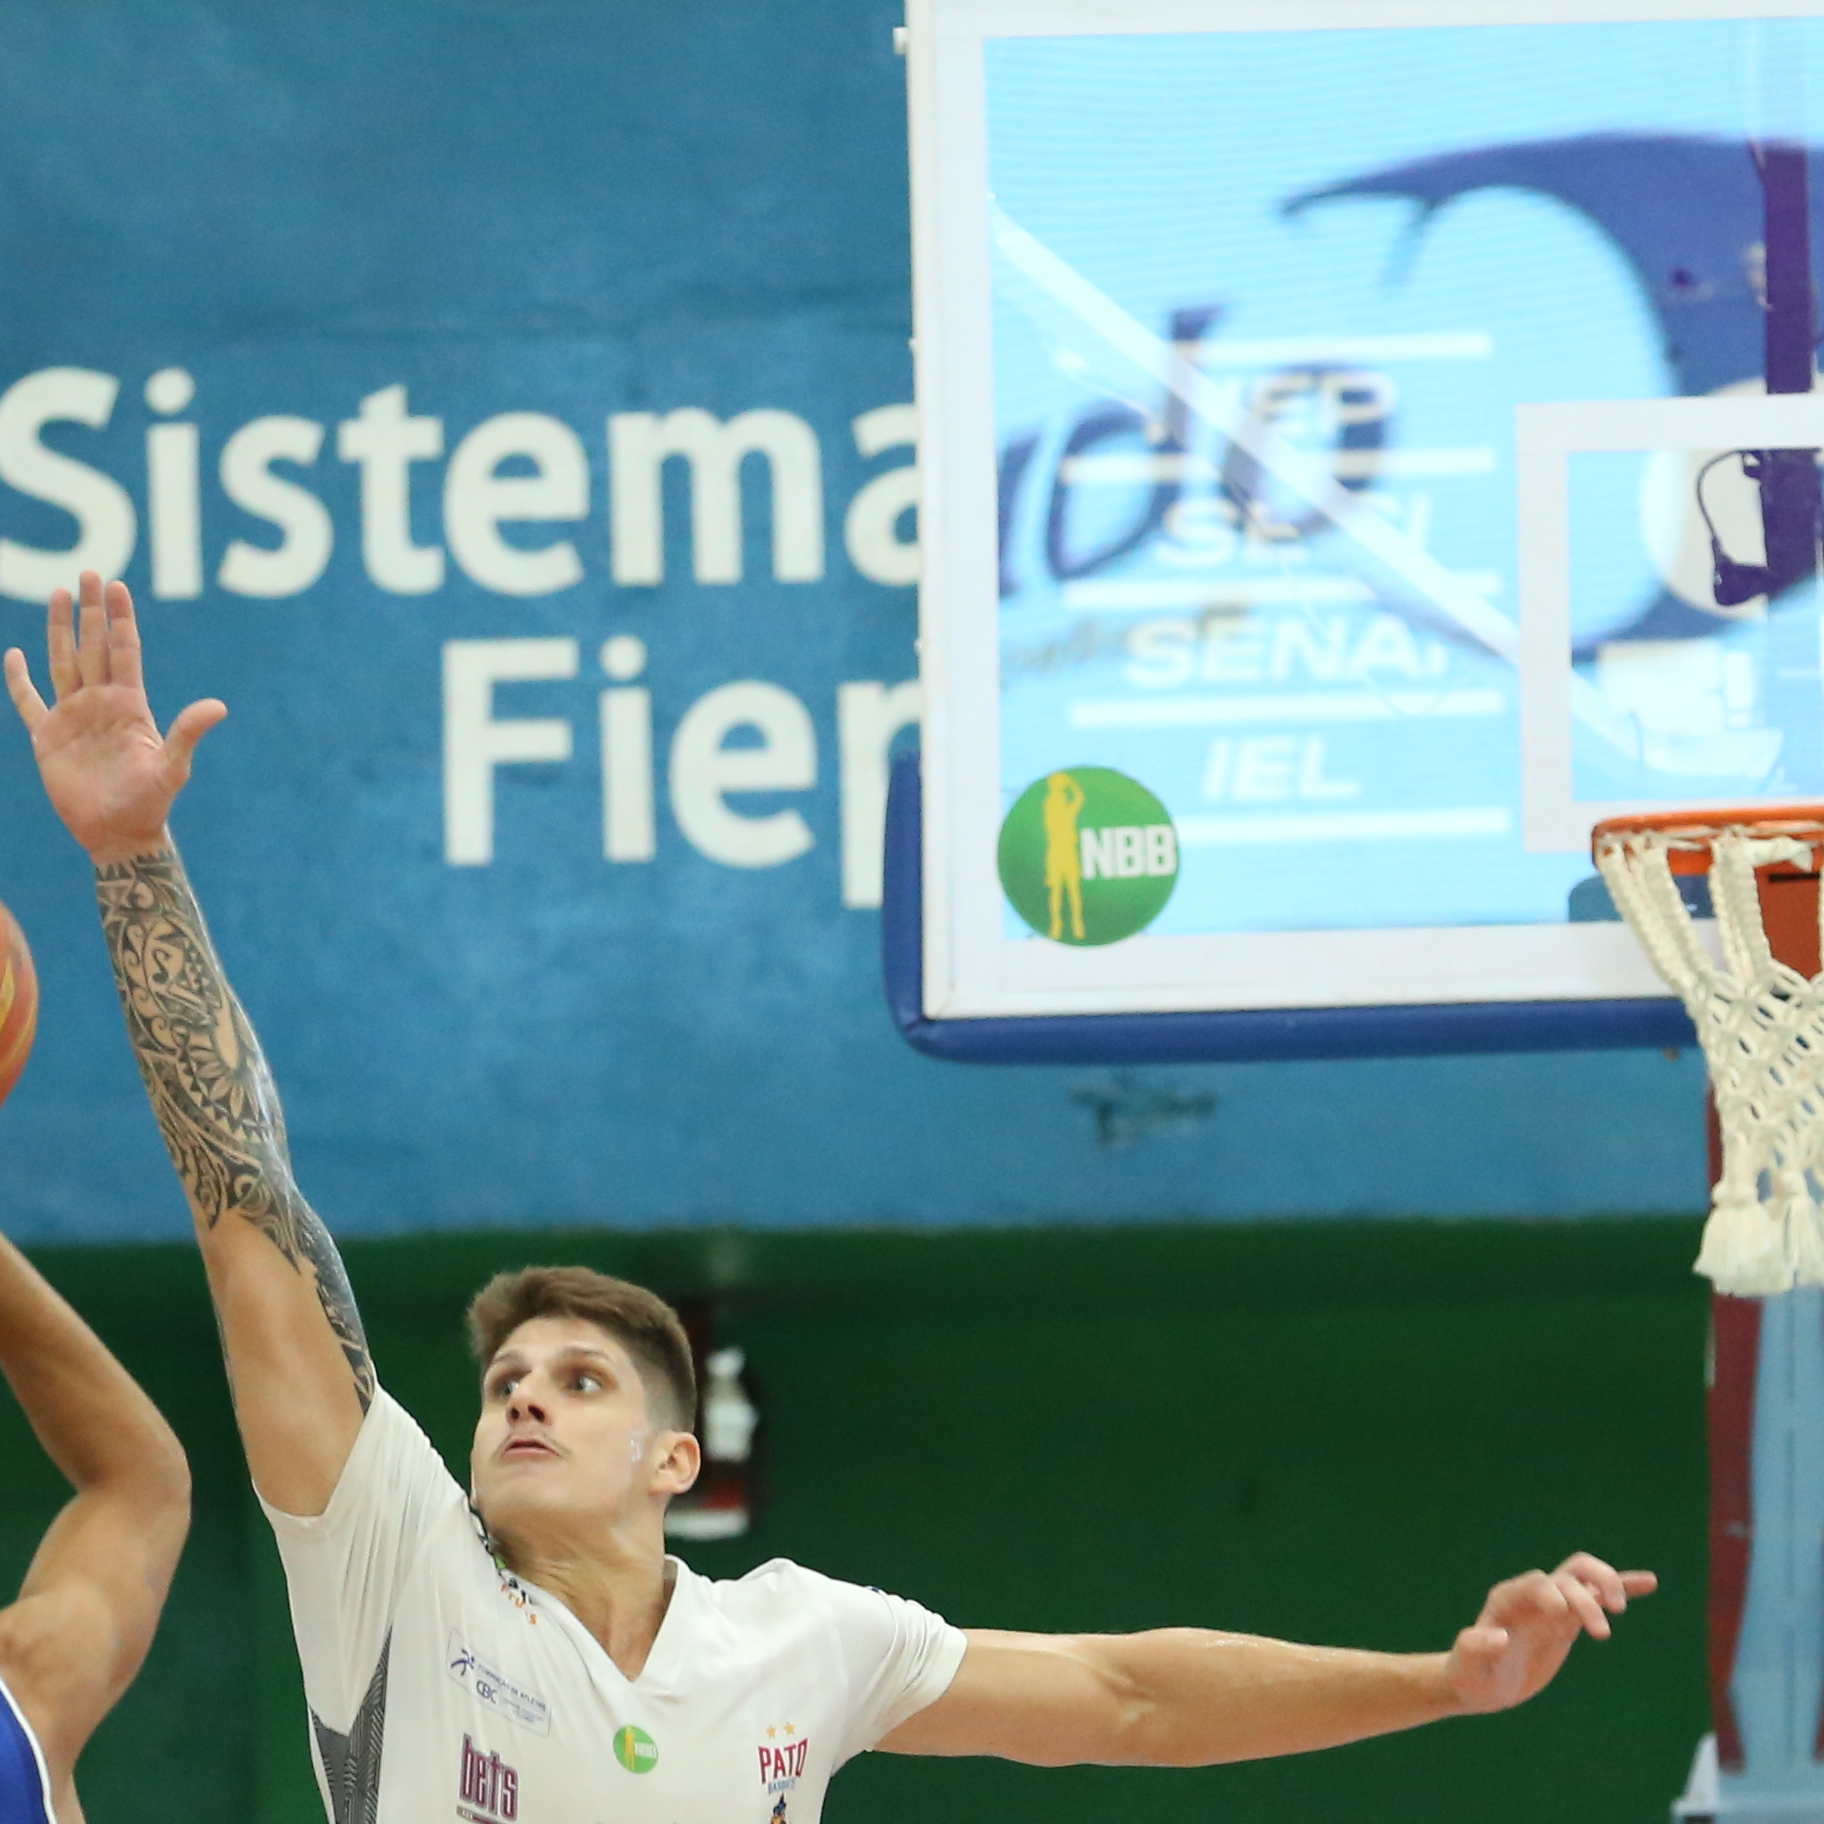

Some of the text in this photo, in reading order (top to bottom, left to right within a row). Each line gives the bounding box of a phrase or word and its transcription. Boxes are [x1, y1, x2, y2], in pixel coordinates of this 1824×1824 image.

[1202, 734, 1363, 802] IEL
[1080, 824, 1176, 879] NBB
[459, 1733, 519, 1821] bets
[758, 1737, 809, 1786] PATO
